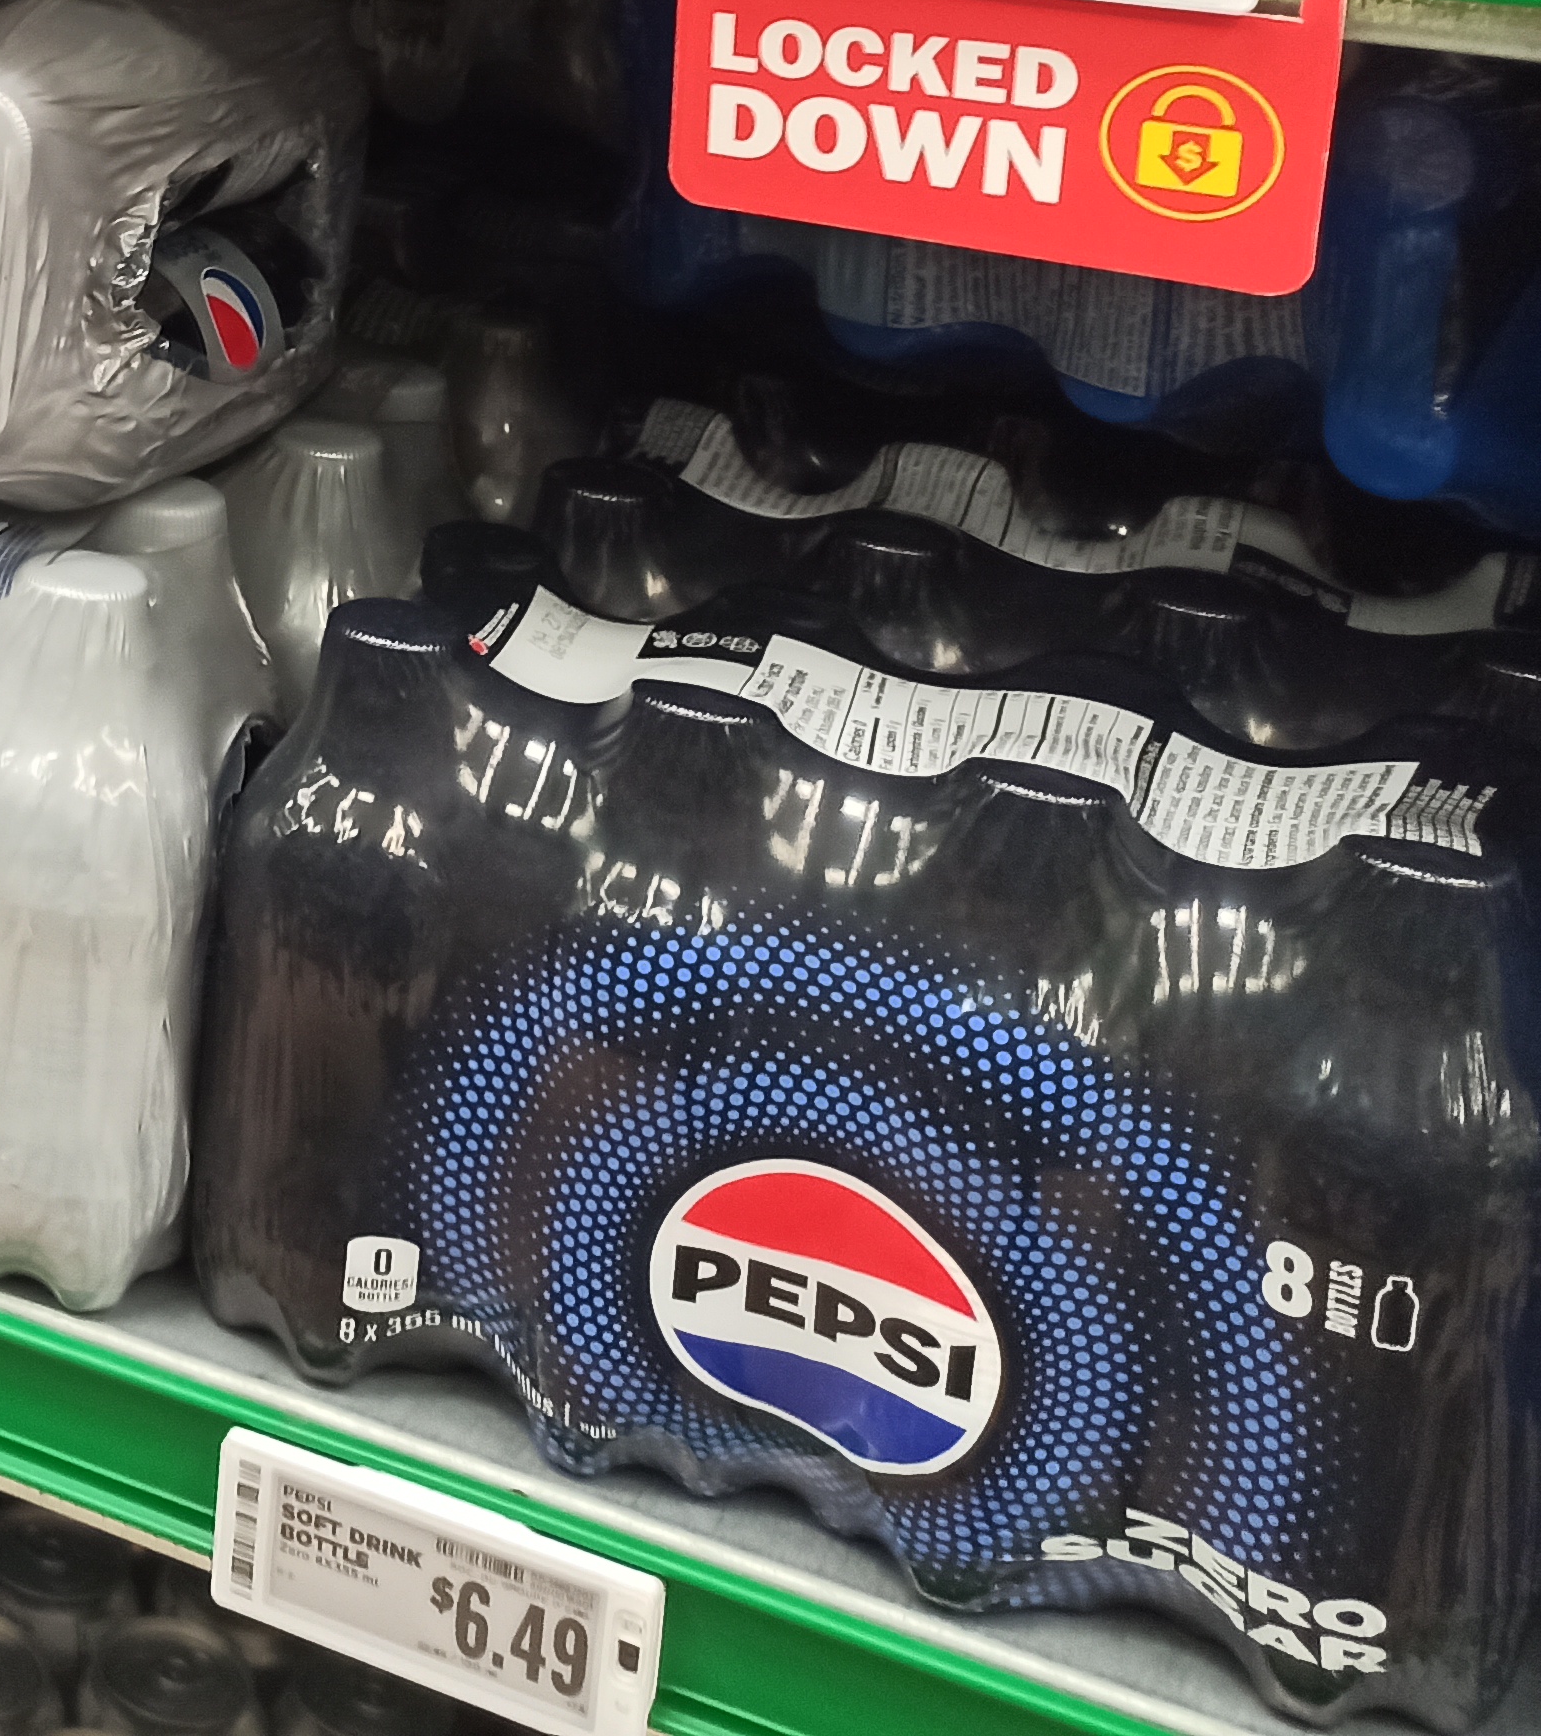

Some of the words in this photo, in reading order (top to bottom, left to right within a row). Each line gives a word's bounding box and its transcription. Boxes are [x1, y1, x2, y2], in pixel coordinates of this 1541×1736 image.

[709, 11, 1080, 111] LOCKED
[706, 82, 1069, 205] DOWN
[373, 1247, 393, 1277] 0
[1259, 1239, 1315, 1321] 8
[1322, 1259, 1364, 1340] BOTTLES
[339, 1316, 356, 1345] 8
[672, 1243, 979, 1404] PEPSI
[279, 1521, 371, 1570] BOTTLE
[280, 1501, 343, 1538] SOFT
[348, 1526, 424, 1569] DRINK
[282, 1483, 334, 1514] PEPSI
[1125, 1506, 1388, 1642] ZERO
[429, 1574, 590, 1698] $6.49
